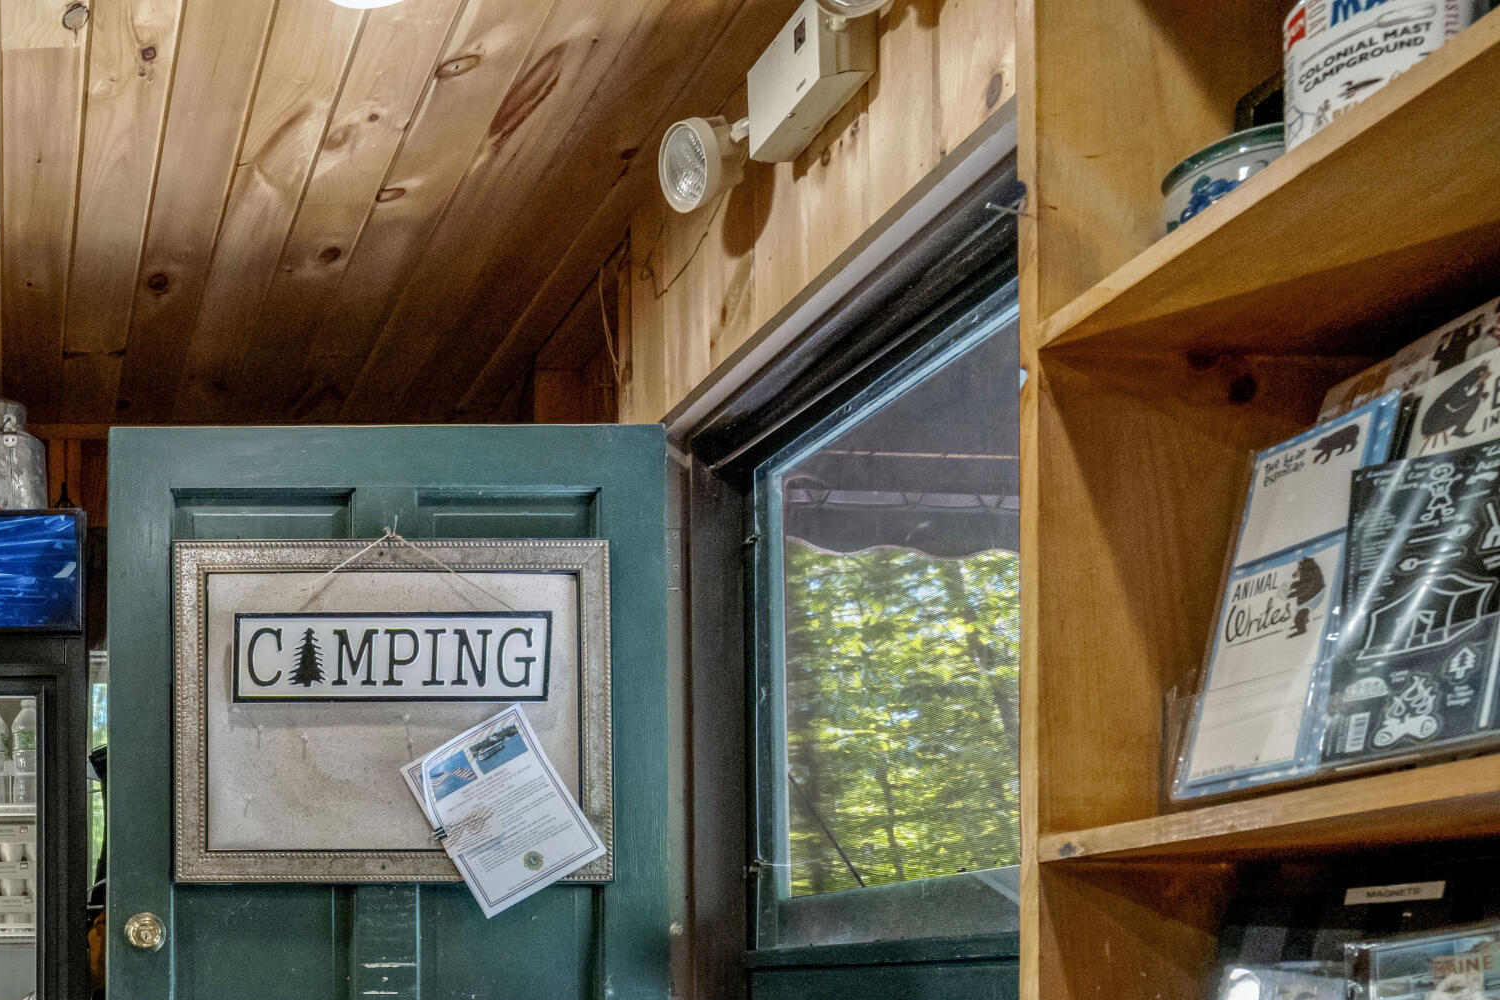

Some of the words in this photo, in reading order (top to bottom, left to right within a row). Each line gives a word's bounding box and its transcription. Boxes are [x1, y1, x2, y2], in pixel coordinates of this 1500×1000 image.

[1298, 36, 1378, 85] COLONIAL
[1383, 21, 1433, 41] MAST
[1303, 36, 1425, 93] CAMPGROUND
[1232, 572, 1278, 603] ANIMAL
[1225, 597, 1292, 643] Writes
[1367, 887, 1420, 898] MAGNETS
